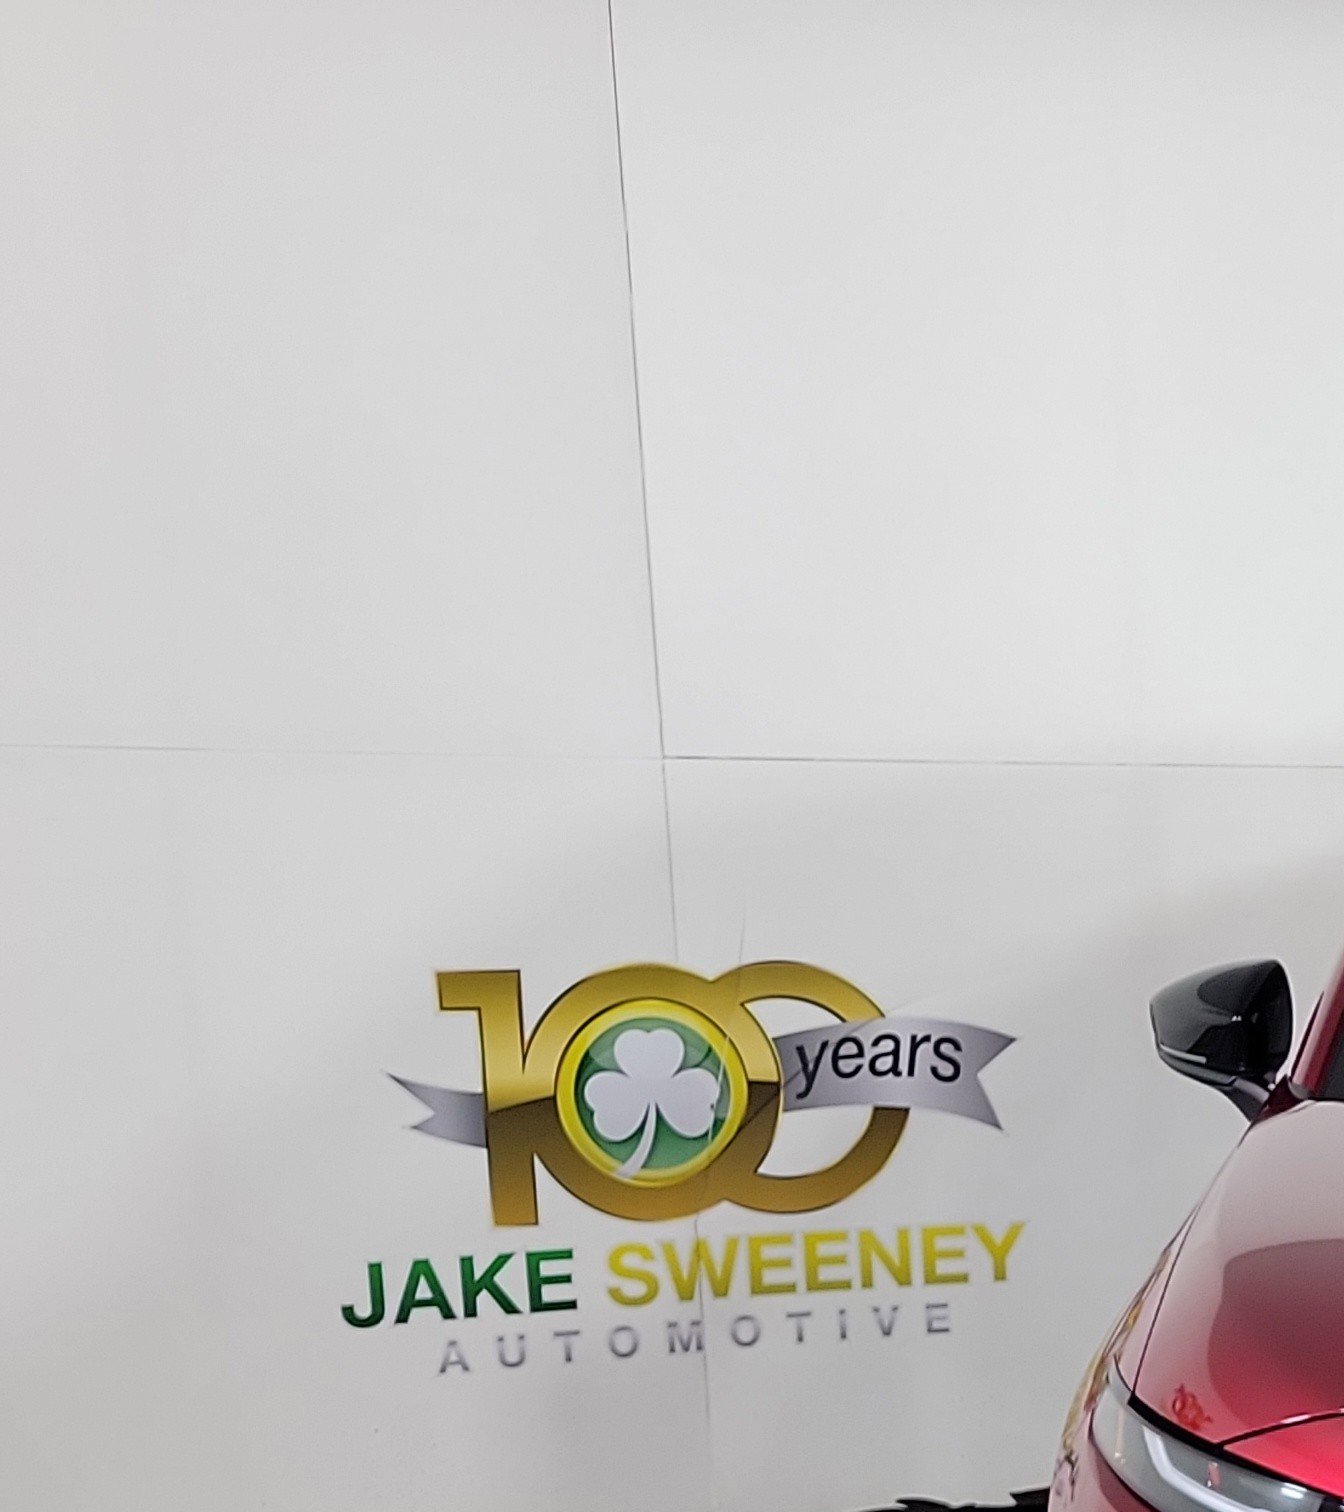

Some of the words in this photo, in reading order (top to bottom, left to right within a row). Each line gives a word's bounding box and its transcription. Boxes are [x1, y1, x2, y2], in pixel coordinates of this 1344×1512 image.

[435, 960, 911, 1228] 100
[794, 1029, 963, 1098] years
[340, 1247, 578, 1329] JAKE
[606, 1221, 1026, 1307] SWEENEY
[437, 1303, 952, 1376] AUTOMOTIVE
